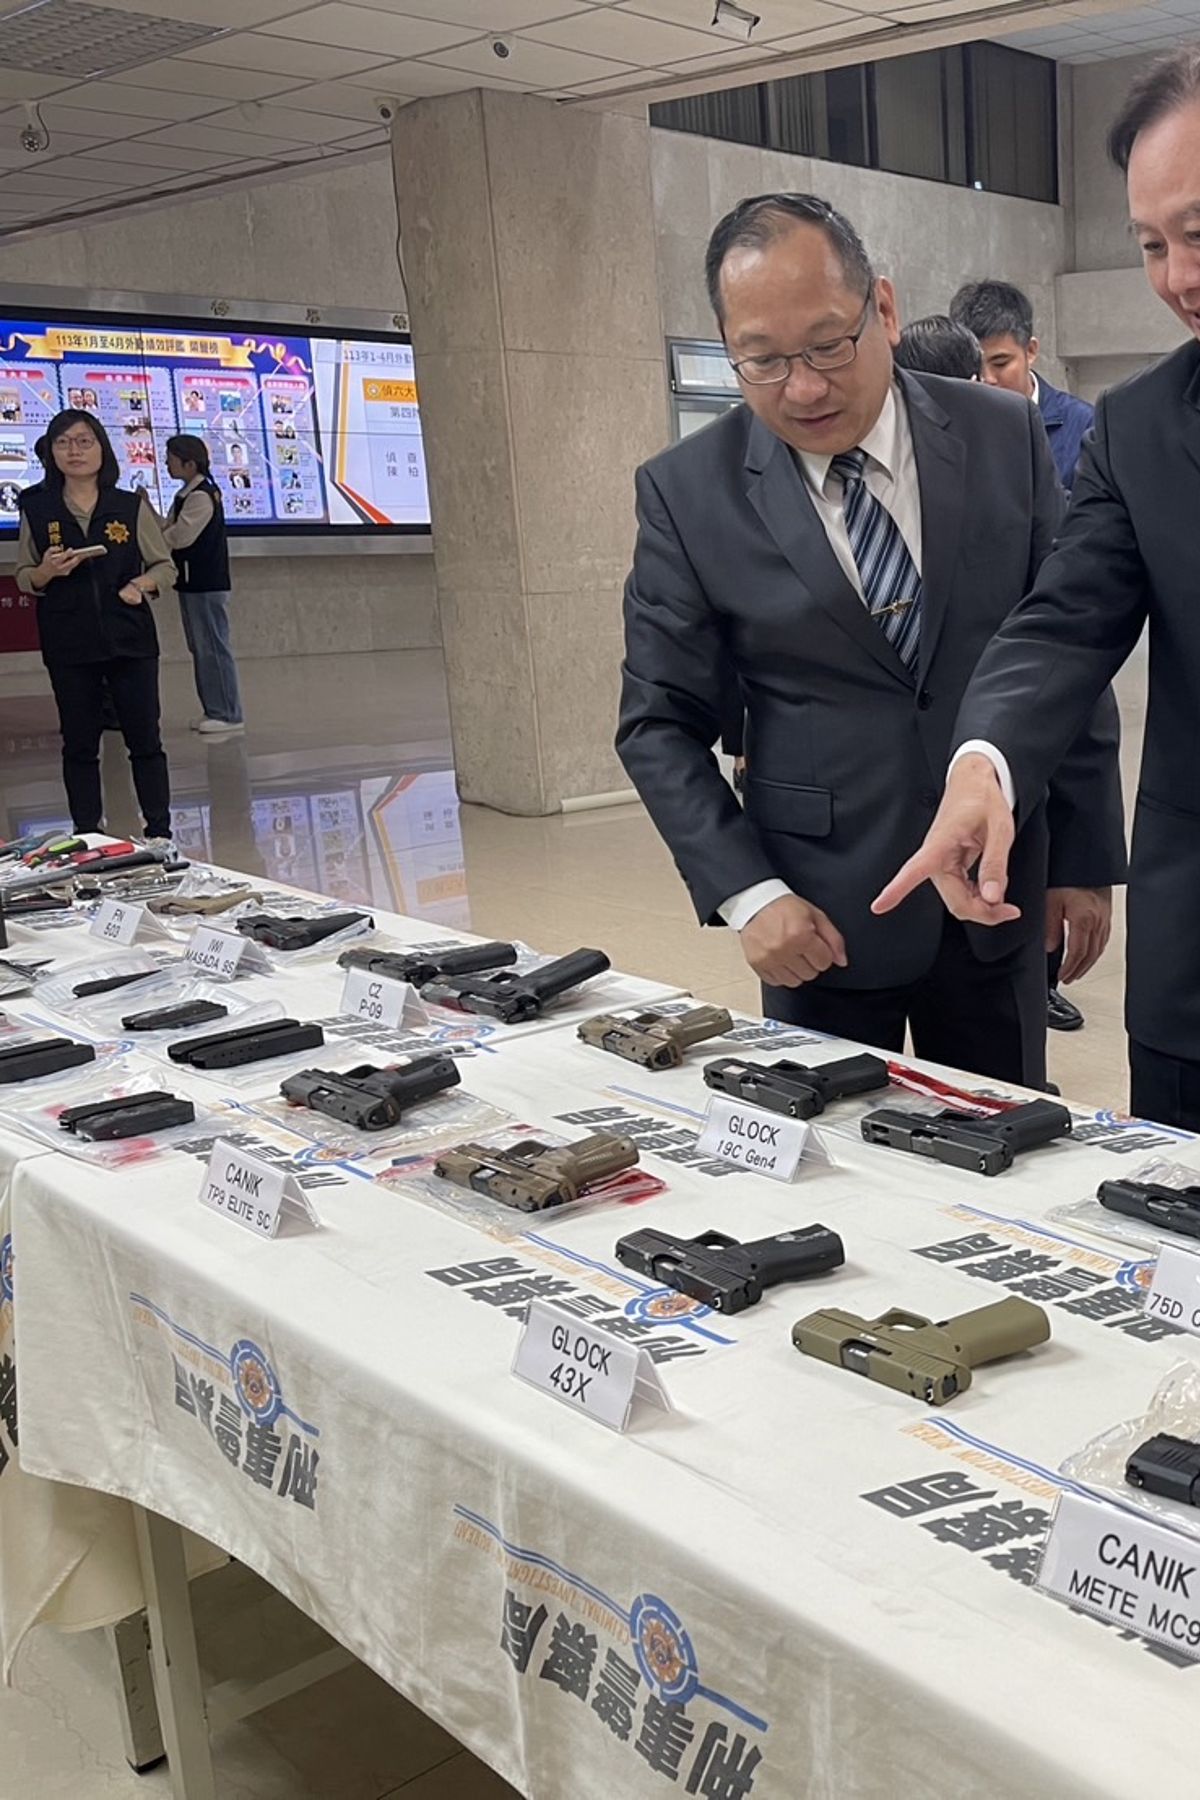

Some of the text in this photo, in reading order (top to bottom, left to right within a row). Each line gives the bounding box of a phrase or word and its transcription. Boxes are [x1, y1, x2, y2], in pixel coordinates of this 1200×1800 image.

[184, 947, 220, 972] MASADA
[368, 982, 383, 999] CZ
[359, 999, 383, 1020] P-09
[728, 1114, 782, 1147] GLOCK
[716, 1139, 778, 1170] 19C Gen4
[225, 1162, 264, 1198] CANIK
[207, 1183, 271, 1230] TP9 ELITE SC
[1148, 1292, 1185, 1320] 75D
[551, 1325, 612, 1377] GLOCK
[549, 1362, 593, 1403] 43X
[1097, 1533, 1197, 1600] CANIK
[1068, 1569, 1139, 1620] METE
